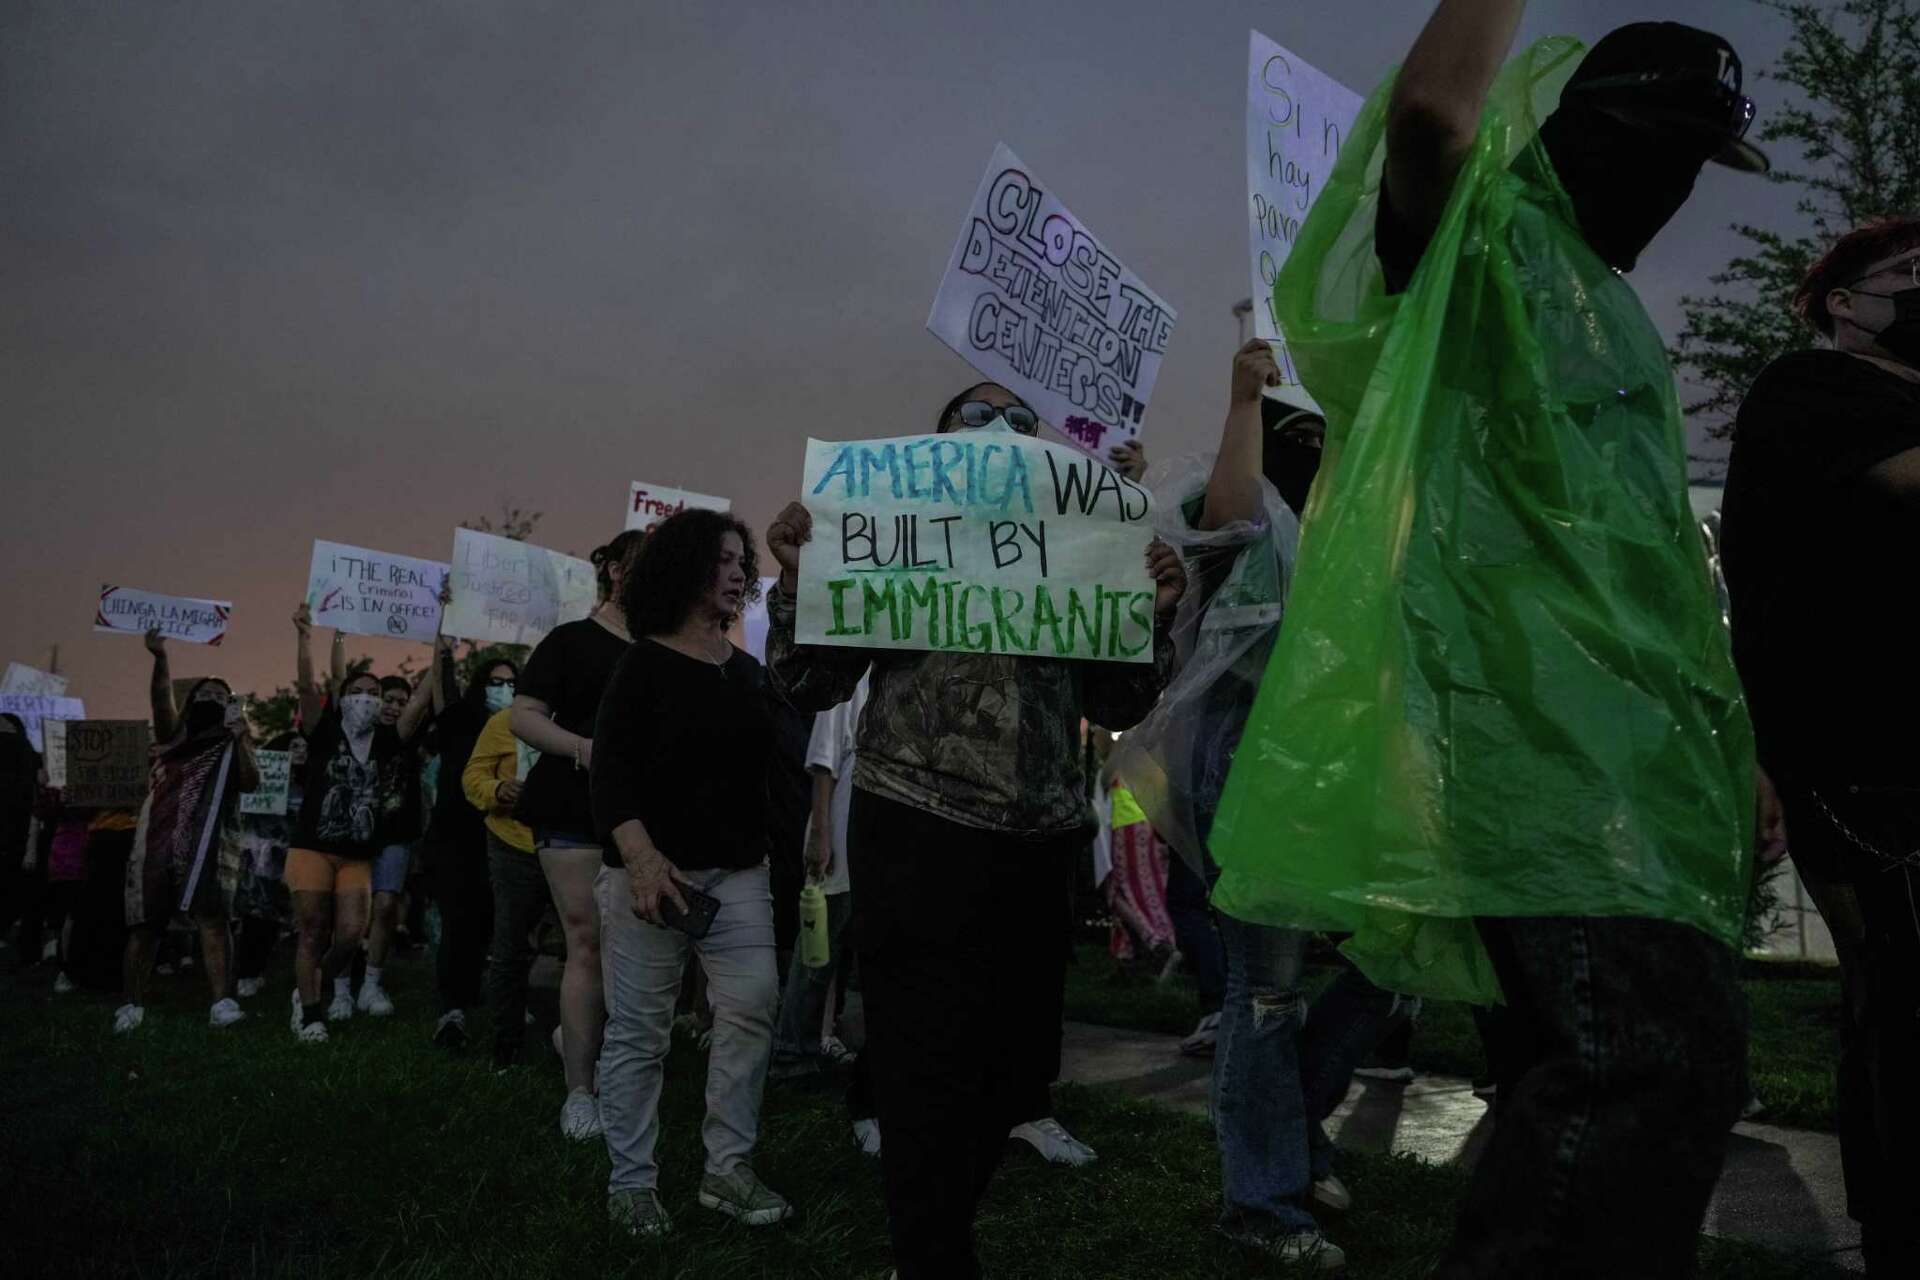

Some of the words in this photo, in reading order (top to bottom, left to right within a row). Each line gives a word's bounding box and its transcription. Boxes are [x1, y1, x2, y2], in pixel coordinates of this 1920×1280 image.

[1267, 130, 1310, 210] hay
[987, 168, 1121, 317] CLOSE
[1119, 283, 1178, 356] THE
[960, 217, 1142, 388] DETENTION
[812, 439, 1033, 514] AMERICA
[1045, 450, 1148, 522] WAS
[389, 564, 432, 588] REAL
[842, 512, 962, 569] BUILT
[990, 520, 1048, 577] BY
[360, 596, 384, 613] IN
[825, 576, 1153, 657] IMMIGRANTS
